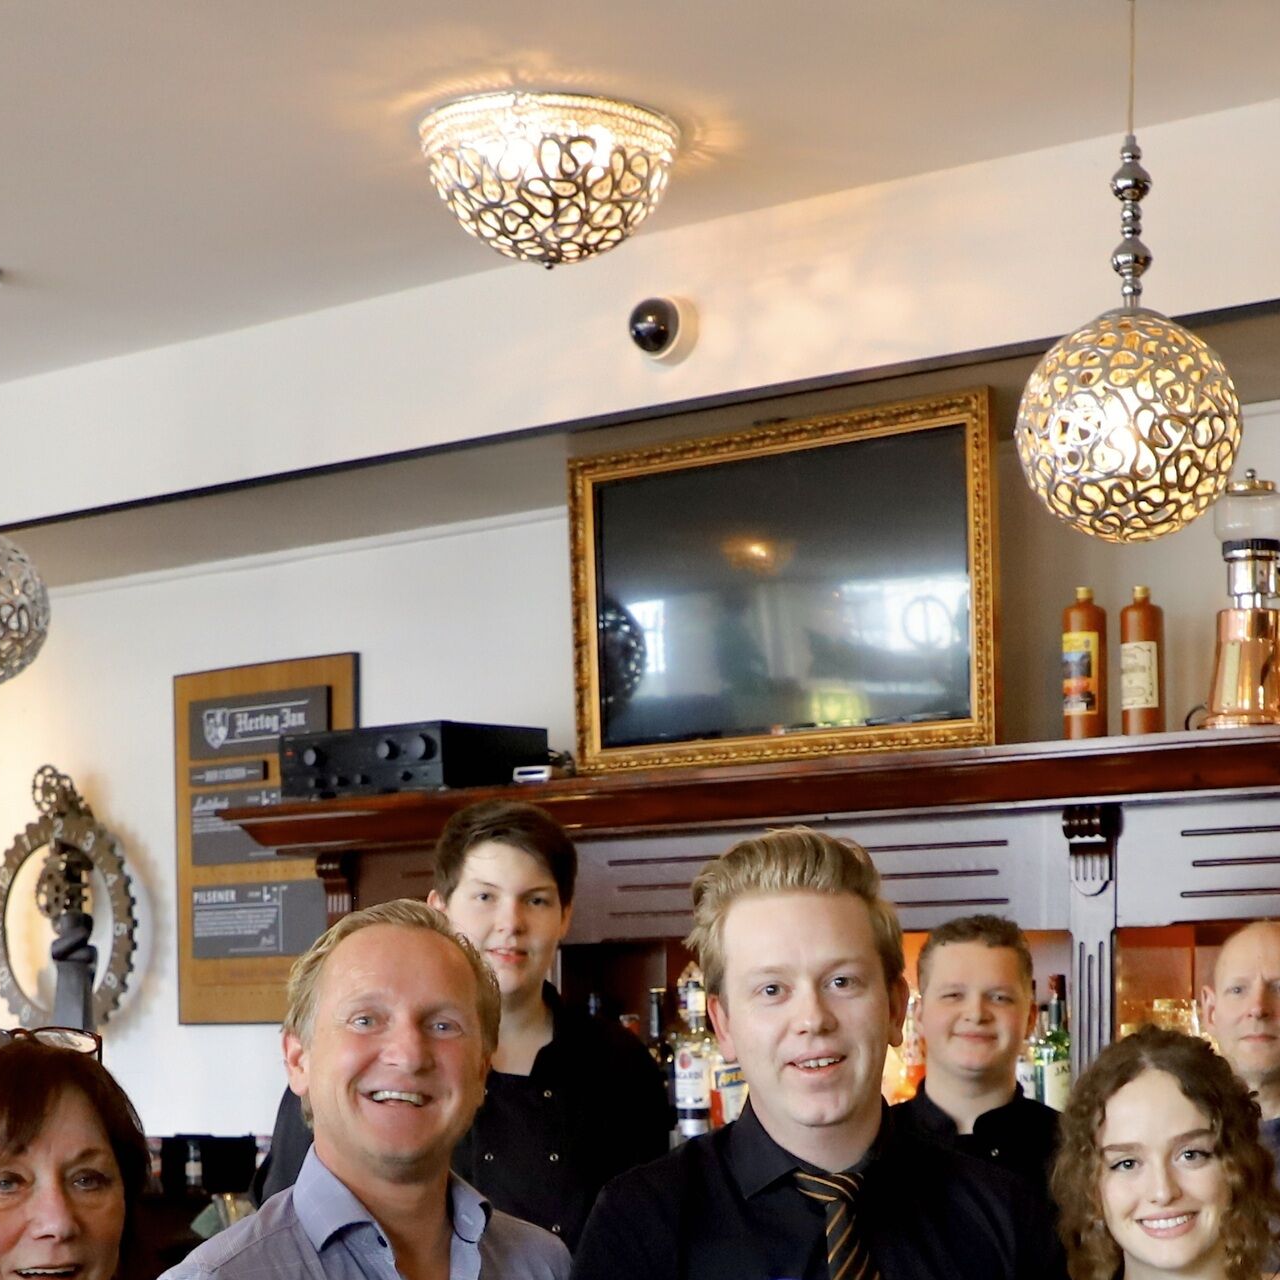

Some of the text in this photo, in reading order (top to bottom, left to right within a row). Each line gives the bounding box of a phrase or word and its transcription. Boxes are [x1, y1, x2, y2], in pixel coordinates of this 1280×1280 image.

[235, 708, 306, 734] Hertog Jan
[193, 889, 236, 903] PILSENER
